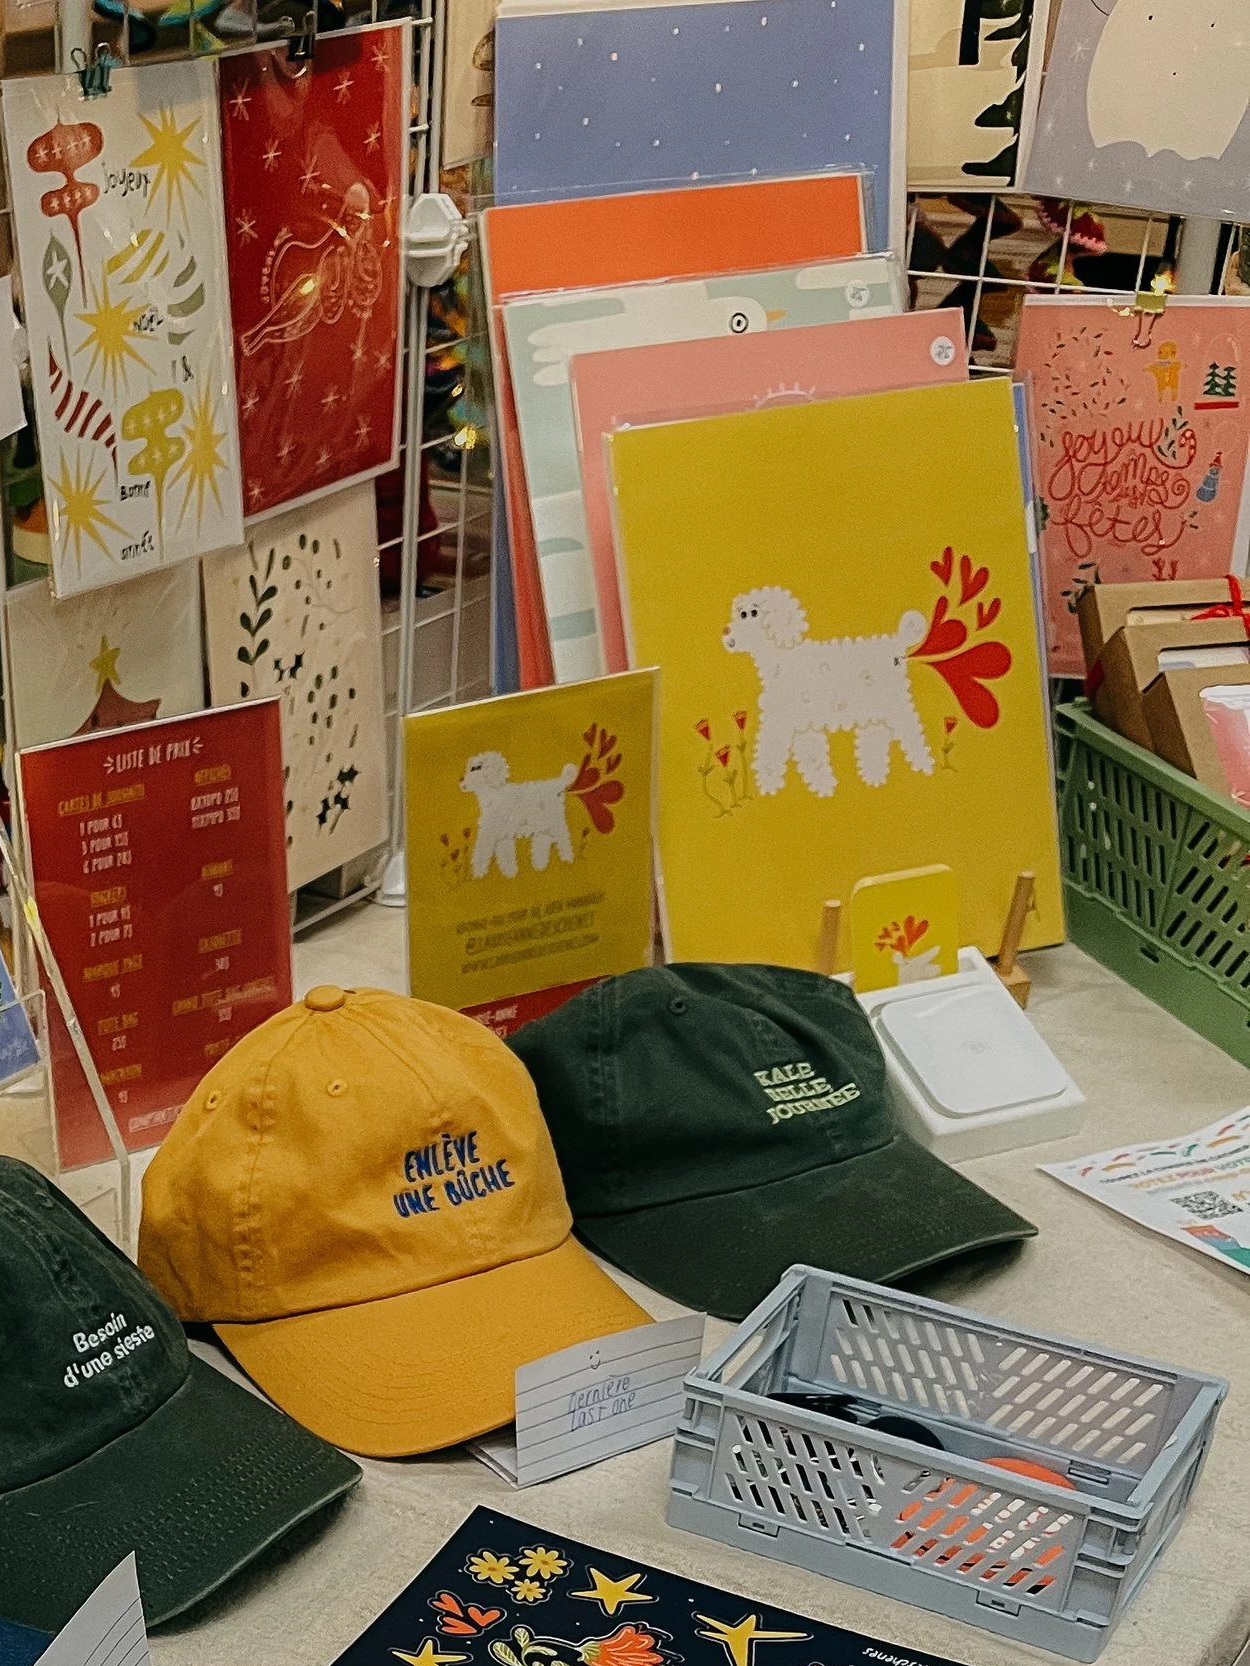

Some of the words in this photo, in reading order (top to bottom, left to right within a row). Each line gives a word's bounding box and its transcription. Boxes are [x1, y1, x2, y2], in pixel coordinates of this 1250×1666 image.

[753, 1062, 815, 1087] KALE
[403, 1130, 481, 1183] ENLÈVE
[393, 1184, 440, 1218] UNE
[444, 1158, 516, 1206] BÛCHE
[72, 1312, 128, 1353] Besoin
[63, 1351, 114, 1388] d'une
[113, 1325, 155, 1359] sieste
[612, 1391, 637, 1416] one
